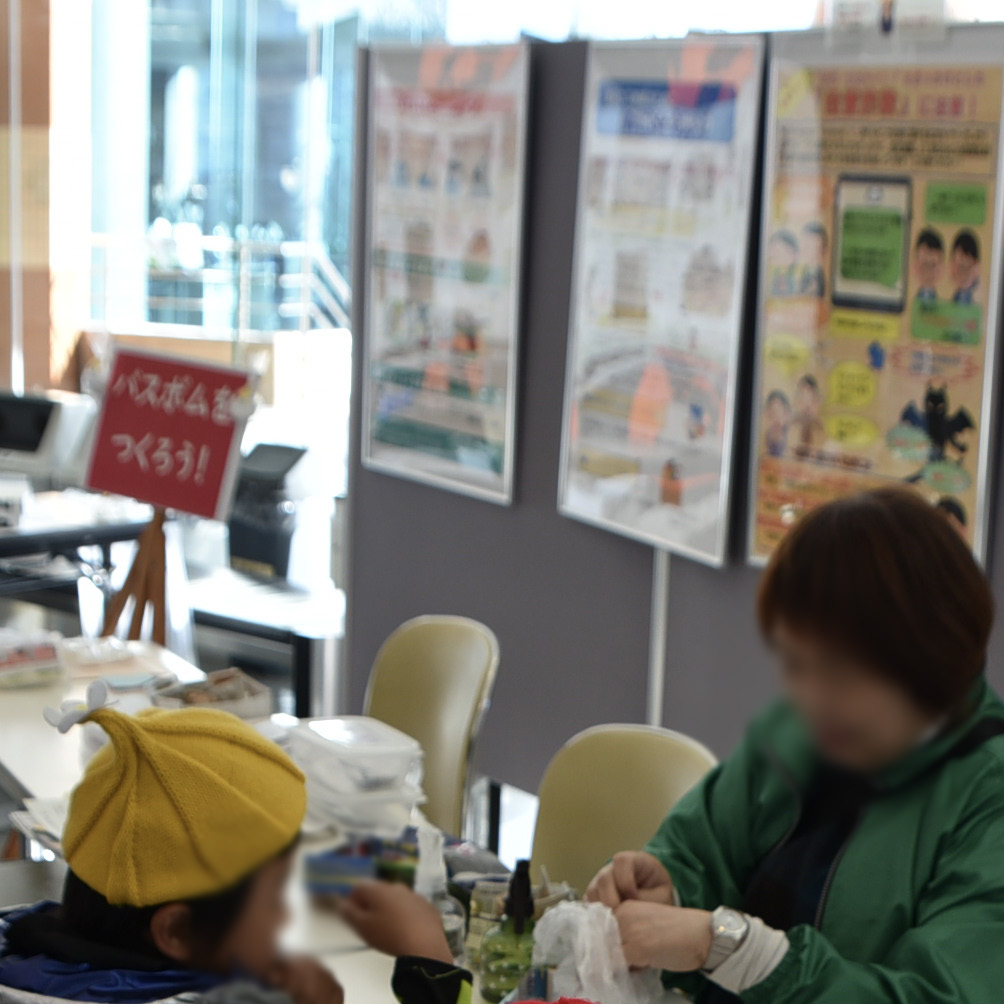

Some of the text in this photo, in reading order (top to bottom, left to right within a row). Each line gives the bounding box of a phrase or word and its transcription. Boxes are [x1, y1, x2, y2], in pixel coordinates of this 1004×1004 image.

[112, 368, 240, 427] バスボムを
